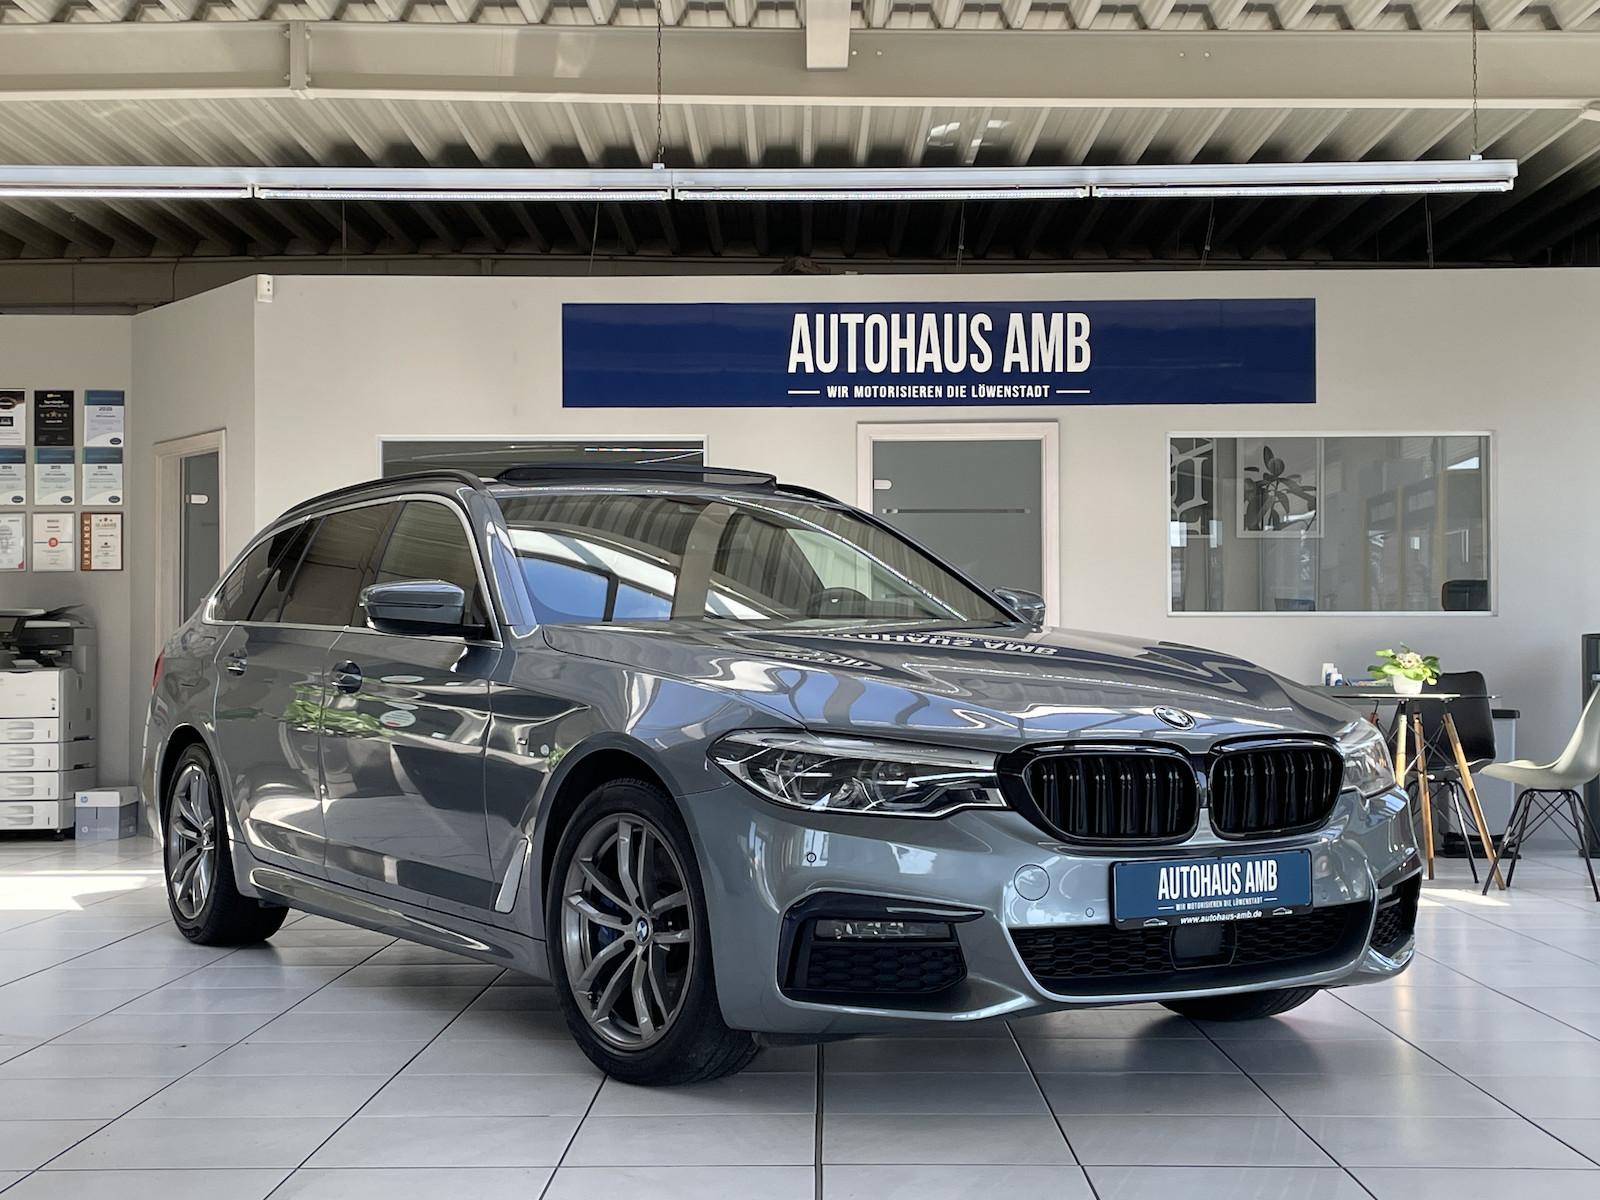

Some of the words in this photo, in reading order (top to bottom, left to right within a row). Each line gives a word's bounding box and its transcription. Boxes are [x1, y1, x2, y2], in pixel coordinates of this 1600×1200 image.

[787, 313, 993, 374] AUTOHAUS
[1003, 312, 1091, 373] AMB
[827, 386, 849, 398] WIR
[854, 386, 943, 398] MOTORISIEREN
[947, 385, 966, 398] DIE
[971, 383, 1050, 398] LÖWENSTADT
[1158, 862, 1242, 900] AUTOHAUS
[1245, 859, 1278, 893] AMB
[1180, 910, 1263, 925] www.autohaus-amb.de
